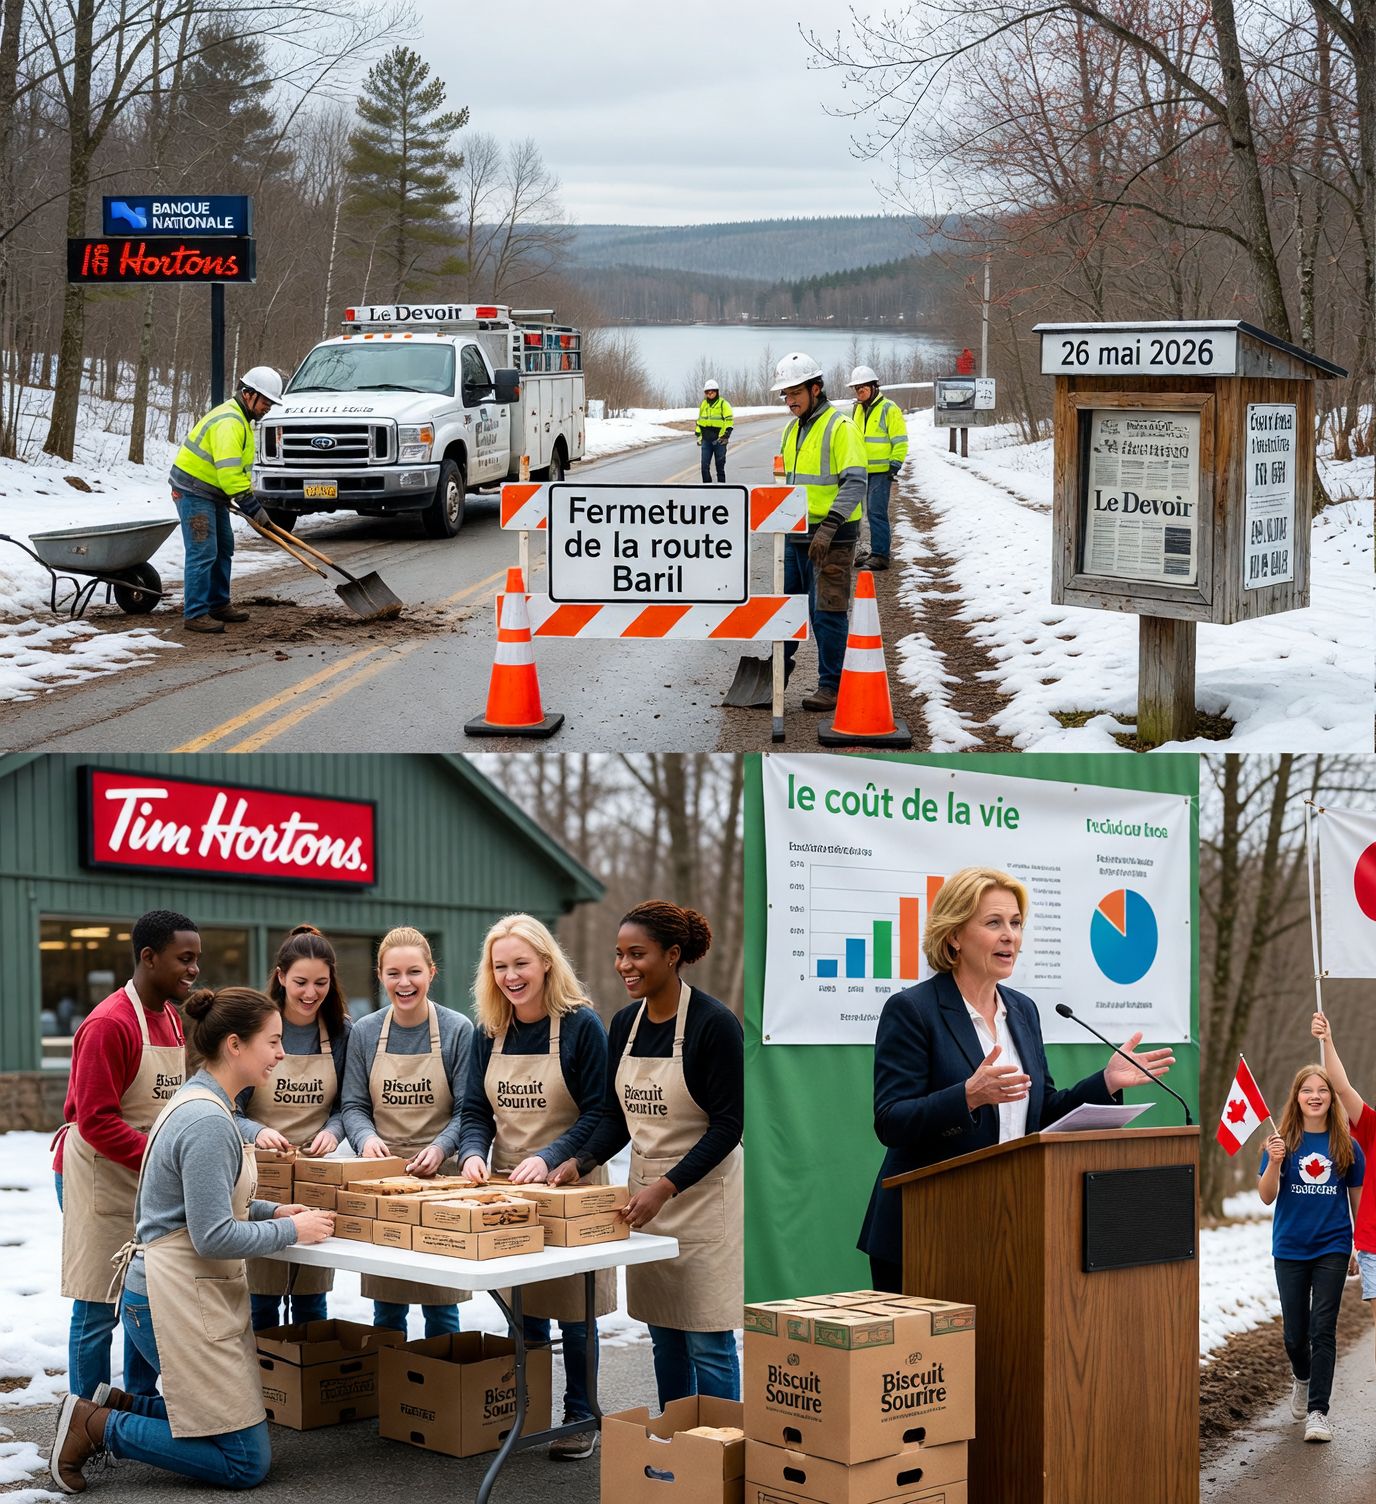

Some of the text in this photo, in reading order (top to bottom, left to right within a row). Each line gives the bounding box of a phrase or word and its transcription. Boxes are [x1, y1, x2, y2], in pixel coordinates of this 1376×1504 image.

[152, 216, 234, 229] NATIONALE
[119, 242, 239, 276] Hortons
[369, 306, 462, 321] Le Devoir
[1061, 339, 1214, 366] 26 mai 2026
[569, 496, 729, 525] Fermeture
[1094, 490, 1193, 518] Le Devoir
[564, 530, 733, 559] de la route
[613, 565, 683, 593] Baril
[787, 774, 1020, 830] le coût de la vie
[105, 788, 192, 856] Tim
[383, 1078, 432, 1093] Biscuit
[767, 1364, 821, 1394] Biscuit
[881, 1362, 945, 1395] Biscuit
[766, 1384, 822, 1414] Sourire
[881, 1385, 947, 1414] Sourire
